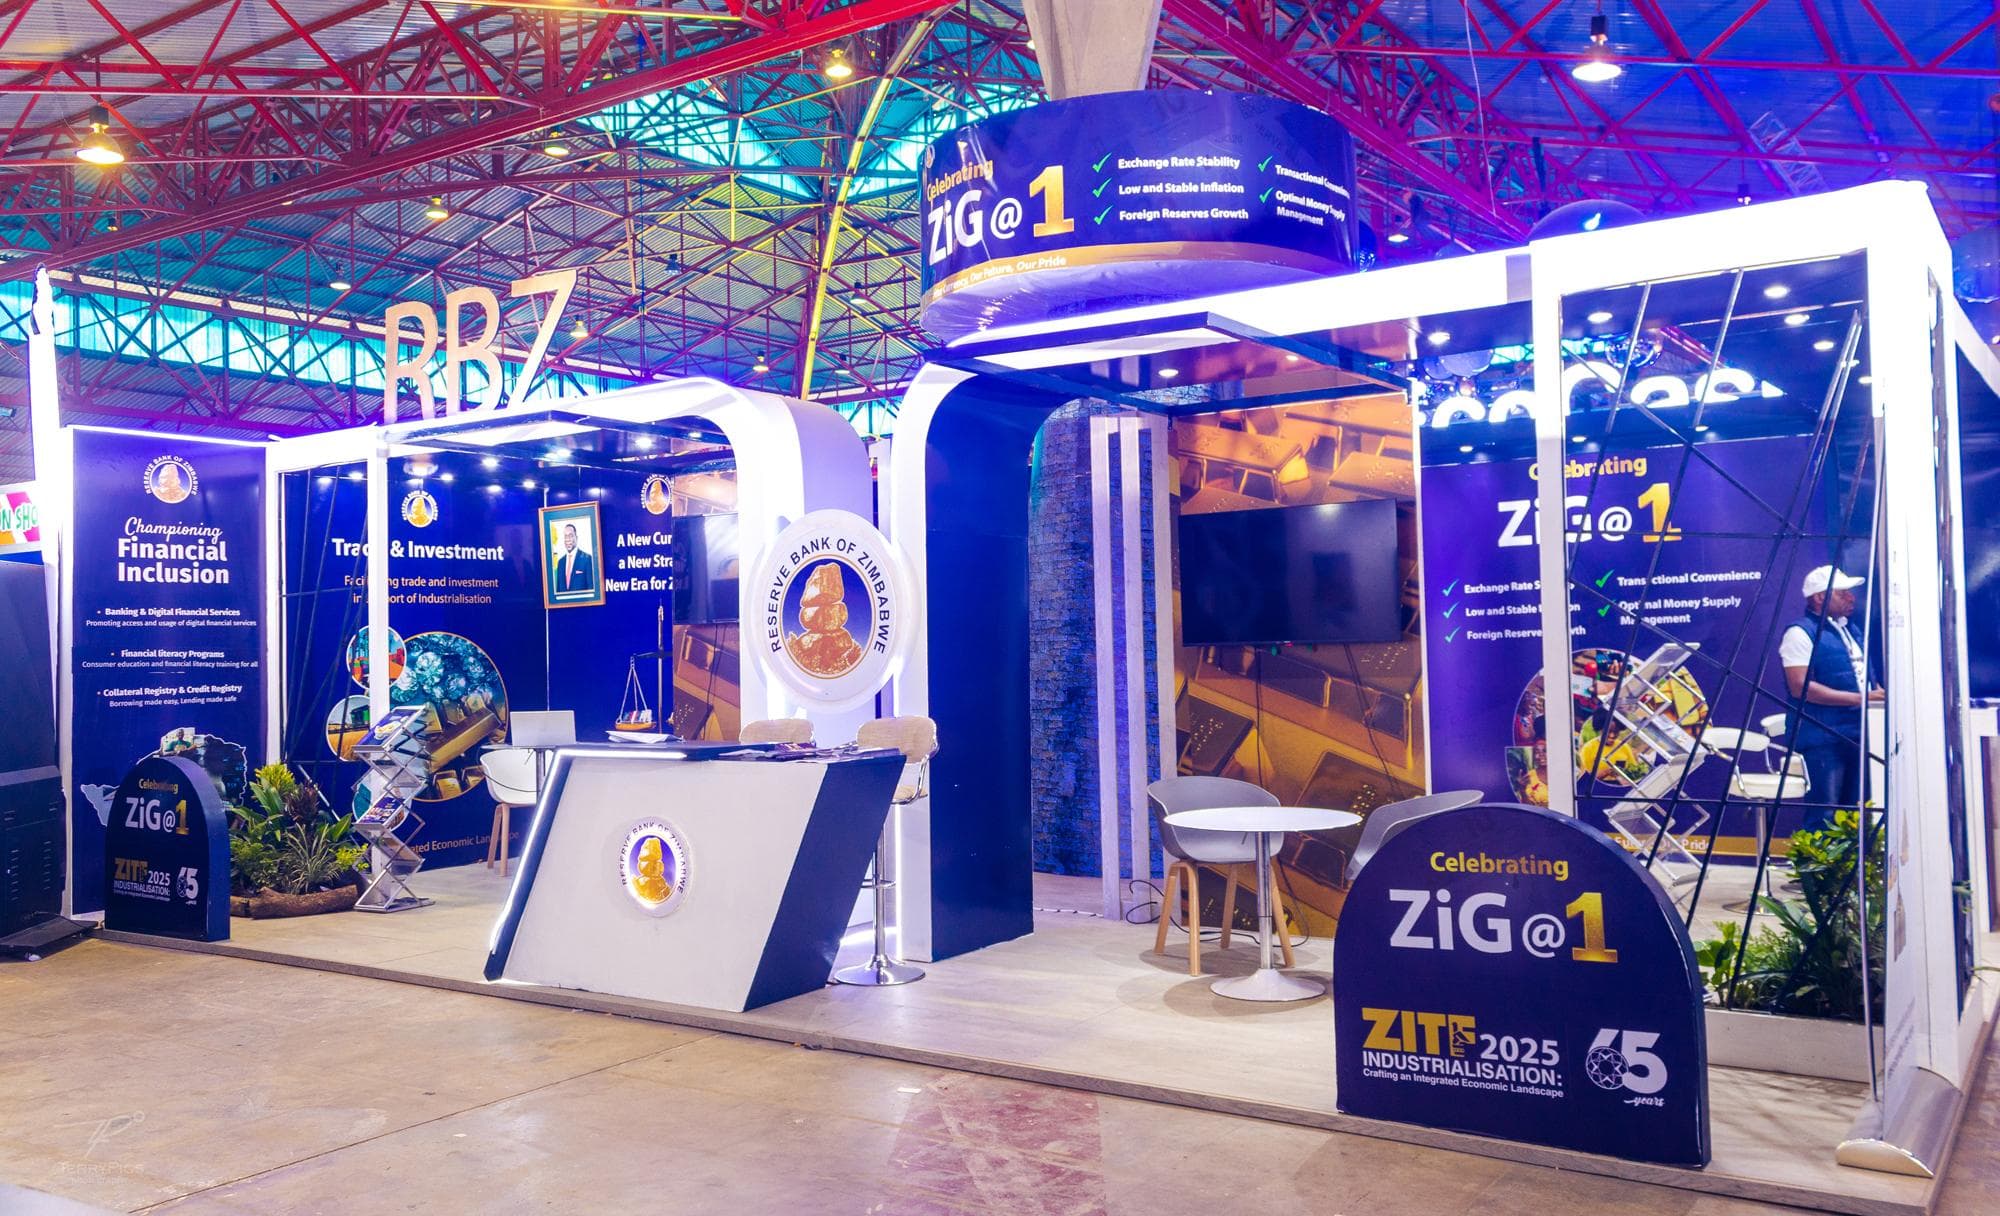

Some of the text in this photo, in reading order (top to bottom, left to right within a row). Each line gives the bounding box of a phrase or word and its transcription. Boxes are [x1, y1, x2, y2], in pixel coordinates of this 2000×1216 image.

[1118, 156, 1240, 169] Exchange Rate Stability
[927, 160, 993, 201] Celebrating
[1275, 164, 1324, 185] Transactional
[1119, 182, 1244, 195] Low and Stable Inflation
[1120, 207, 1248, 221] Foreign Reserves Growth
[1017, 261, 1036, 271] Our
[1038, 257, 1066, 268] Pride
[125, 516, 223, 544] Championing
[617, 534, 625, 547] A
[627, 533, 651, 546] New
[118, 536, 227, 561] Financial
[390, 540, 404, 558] &
[408, 540, 504, 560] Investment
[619, 559, 625, 569] a
[627, 556, 651, 568] New
[118, 561, 229, 584] Inclusion
[1617, 571, 1761, 586] Transctional Convenience
[402, 576, 426, 586] trade
[428, 576, 446, 587] and
[448, 577, 499, 588] investment
[605, 578, 629, 592] New
[631, 577, 648, 591] Era
[650, 576, 667, 590] for
[1464, 584, 1509, 594] Exchange
[1511, 581, 1533, 590] Rate
[407, 593, 416, 603] of
[419, 593, 491, 604] Industrialisation
[768, 536, 890, 654] RESERVE BANK OF ZIMBABWE
[1664, 598, 1701, 610] Money
[1702, 595, 1741, 608] Supply
[105, 608, 139, 617] Banking
[148, 608, 174, 617] Digital
[210, 608, 240, 616] Services
[1465, 608, 1485, 616] Low
[1487, 606, 1505, 615] and
[1506, 604, 1537, 615] Stable
[86, 620, 121, 628] Promoting
[1620, 614, 1691, 626] Maagement
[1467, 630, 1503, 641] Foreign
[1505, 629, 1543, 638] Reserve
[122, 649, 157, 657] Financial
[189, 650, 224, 659] Programs
[103, 684, 242, 696] Collateral Registry & Credit Registry
[109, 699, 143, 707] Borrowing
[432, 836, 474, 850] Economic
[1430, 851, 1569, 881] Celebrating
[148, 870, 171, 886] 2025
[1480, 1033, 1560, 1066] 2025
[1362, 1050, 1563, 1086] INDUSTRIALISATION:
[1363, 1068, 1564, 1099] Crafting an Integrated Economic Landscape
[1624, 1097, 1665, 1107] years
